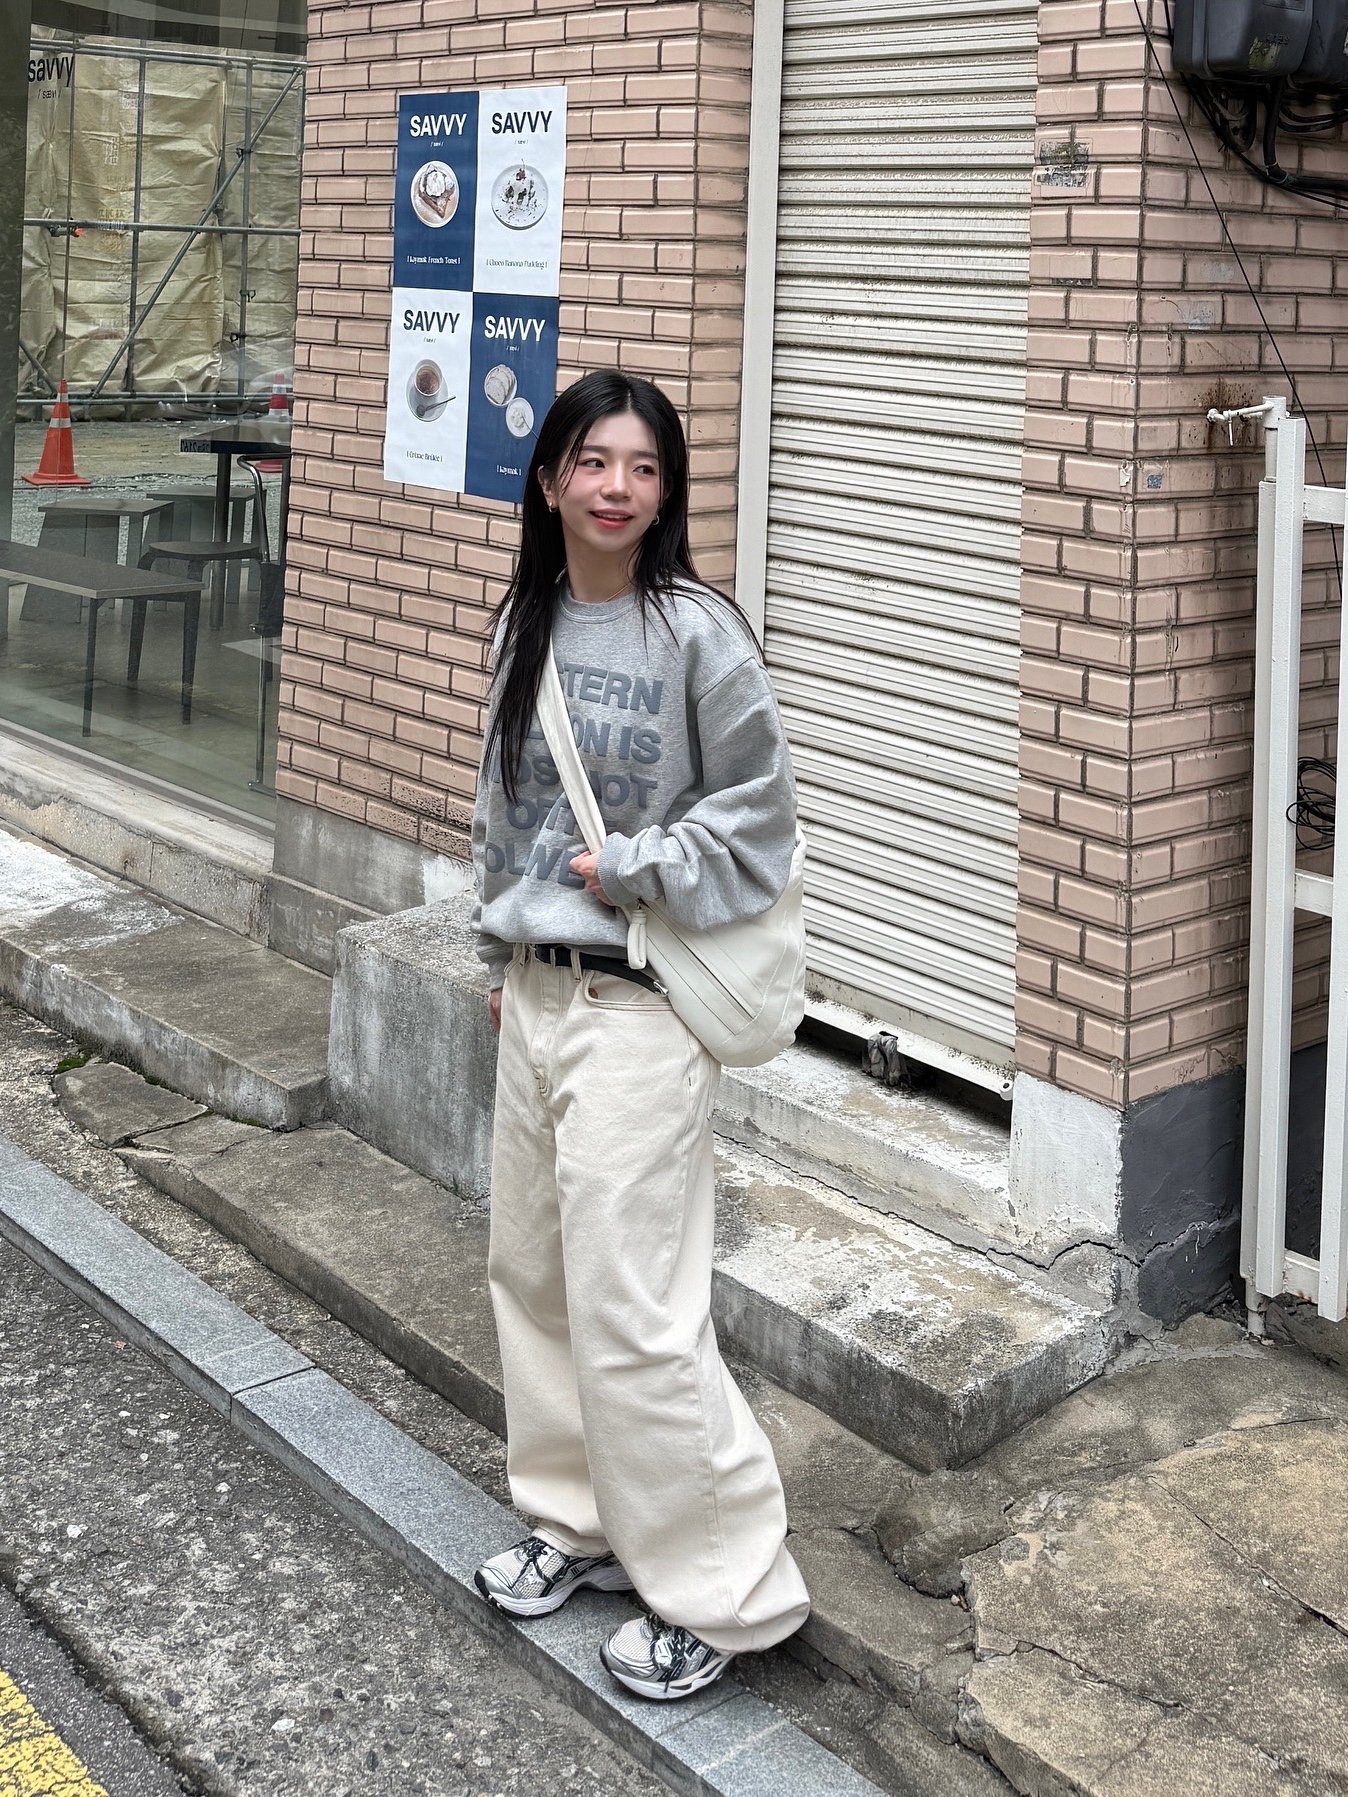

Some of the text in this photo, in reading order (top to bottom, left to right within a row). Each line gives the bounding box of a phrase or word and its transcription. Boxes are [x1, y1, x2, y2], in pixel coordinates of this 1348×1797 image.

[28, 56, 74, 87] savvy
[410, 113, 467, 137] SAVVY
[491, 110, 552, 134] SAVVY
[403, 309, 460, 333] SAVVY
[484, 315, 546, 341] SAVVY
[619, 726, 662, 764] IS
